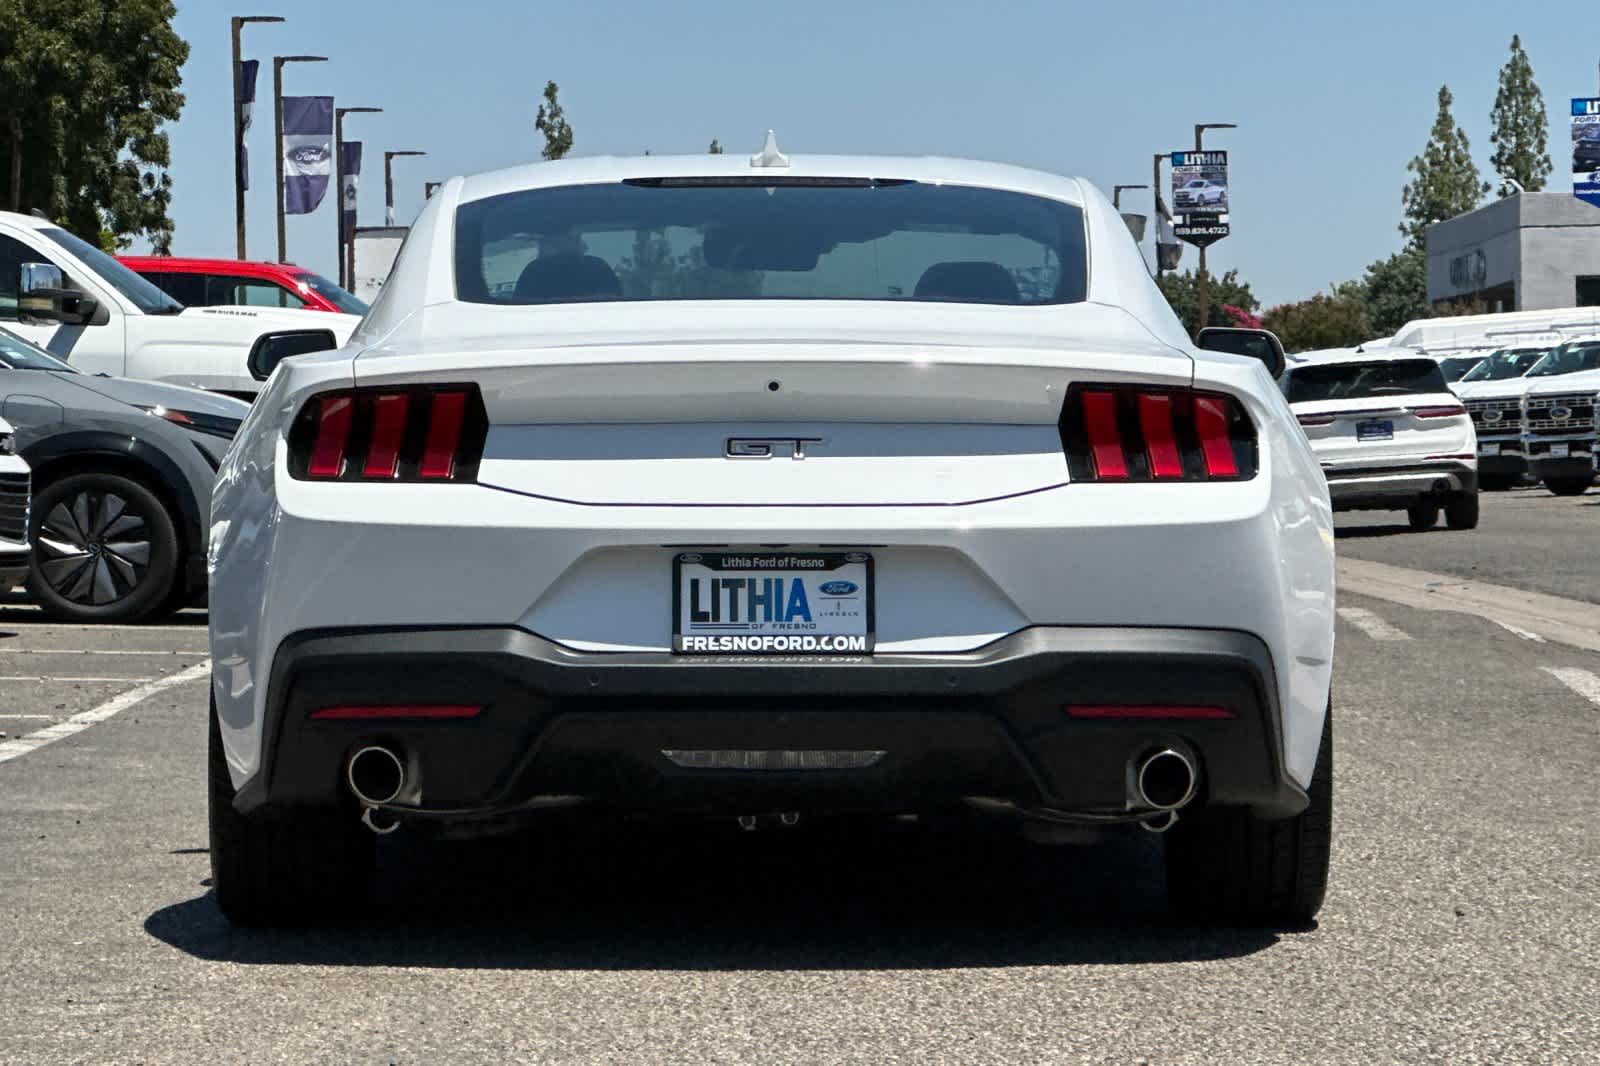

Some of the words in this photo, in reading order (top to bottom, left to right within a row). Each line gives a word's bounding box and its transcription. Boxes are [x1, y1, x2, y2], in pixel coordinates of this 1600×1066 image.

[1183, 153, 1225, 165] LITHIA
[726, 437, 823, 458] GT
[721, 556, 751, 568] Lithia
[753, 556, 776, 568] Ford
[777, 556, 789, 568] of
[790, 557, 825, 568] Fresno
[823, 582, 852, 594] Ford
[690, 577, 812, 623] LITHIA
[682, 635, 866, 651] FRESNOFORD.COM
